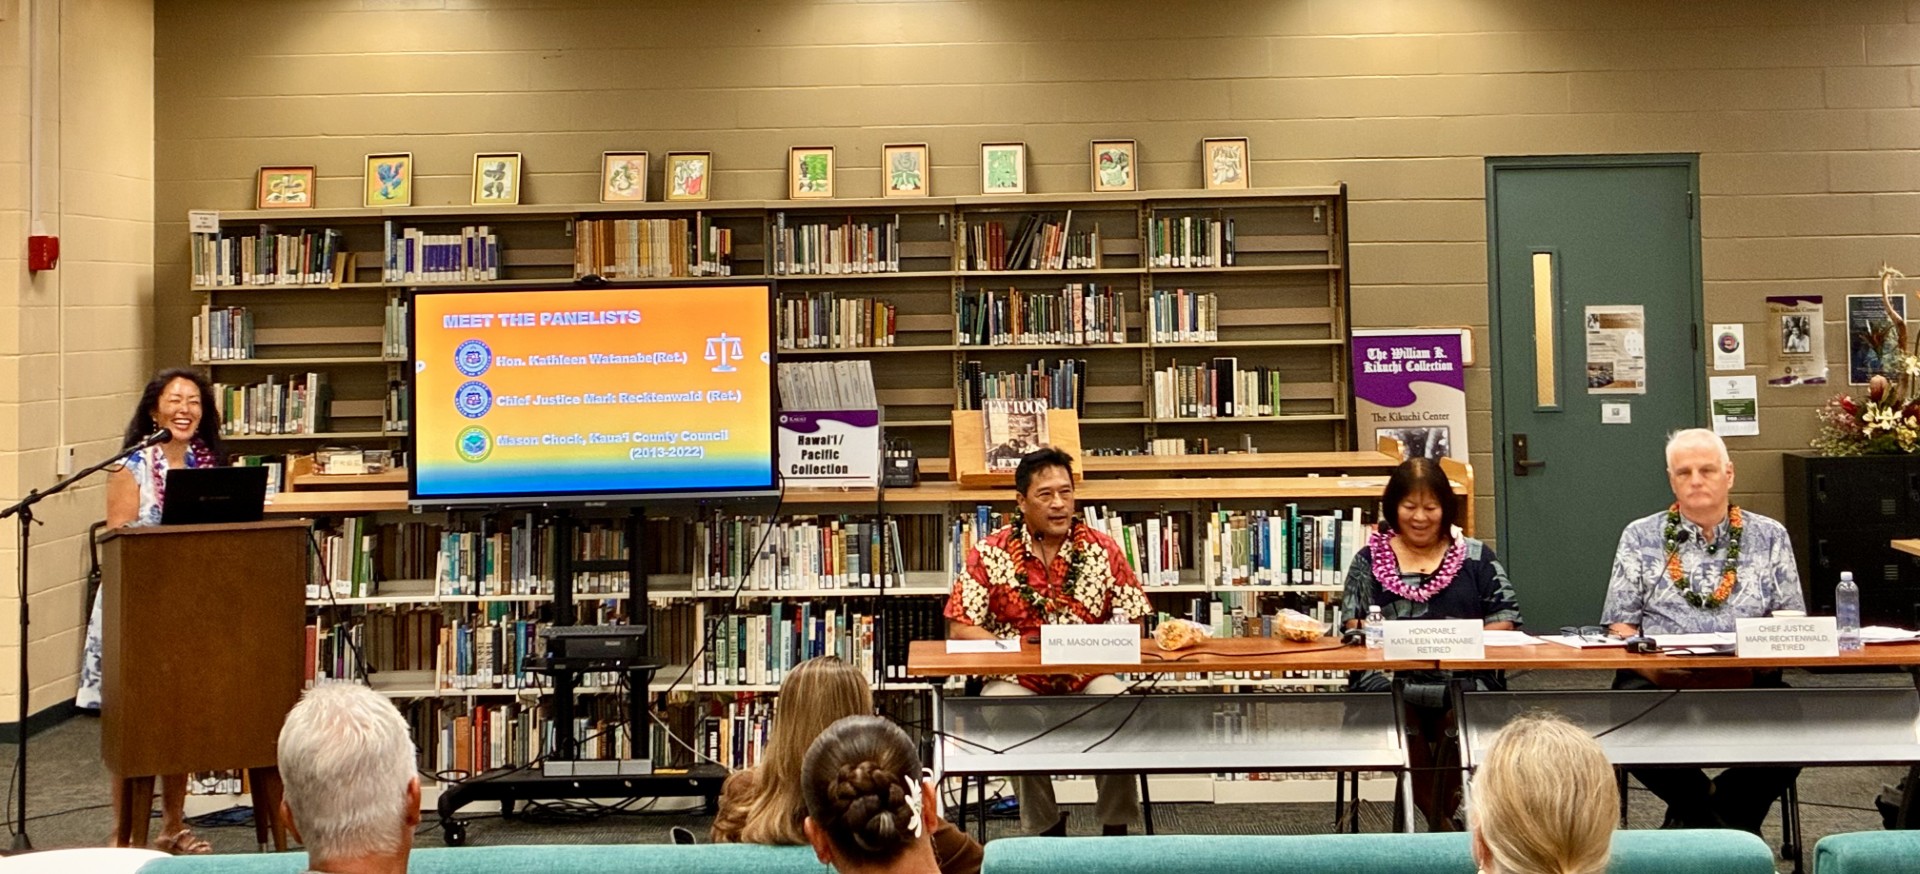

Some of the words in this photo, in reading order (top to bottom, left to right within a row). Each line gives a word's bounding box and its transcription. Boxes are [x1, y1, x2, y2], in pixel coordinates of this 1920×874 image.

[443, 314, 494, 328] MEET
[498, 312, 536, 327] THE
[540, 310, 641, 326] PANELISTS
[496, 356, 526, 366] Hon.
[528, 354, 587, 366] Kathleen
[1367, 348, 1388, 360] The
[1390, 347, 1430, 359] William
[1363, 361, 1402, 374] Kikuchi
[1406, 360, 1453, 372] Collection
[496, 395, 530, 407] Chief
[533, 394, 581, 406] Justice
[584, 393, 616, 404] Mark
[618, 391, 702, 404] Recktenwald
[706, 390, 742, 404] (Ret.)
[984, 400, 1047, 414] TATTOOS
[1371, 412, 1386, 422] The
[1389, 412, 1420, 421] Kikuchi
[1422, 412, 1450, 420] Center
[496, 436, 538, 446] Mason
[542, 434, 586, 445] Chock,
[633, 431, 678, 444] County
[680, 430, 728, 441] Council
[629, 446, 704, 460] (2013-2022)
[802, 449, 839, 460] Pacific
[791, 464, 848, 474] Collection
[1101, 638, 1134, 646] CHOCK
